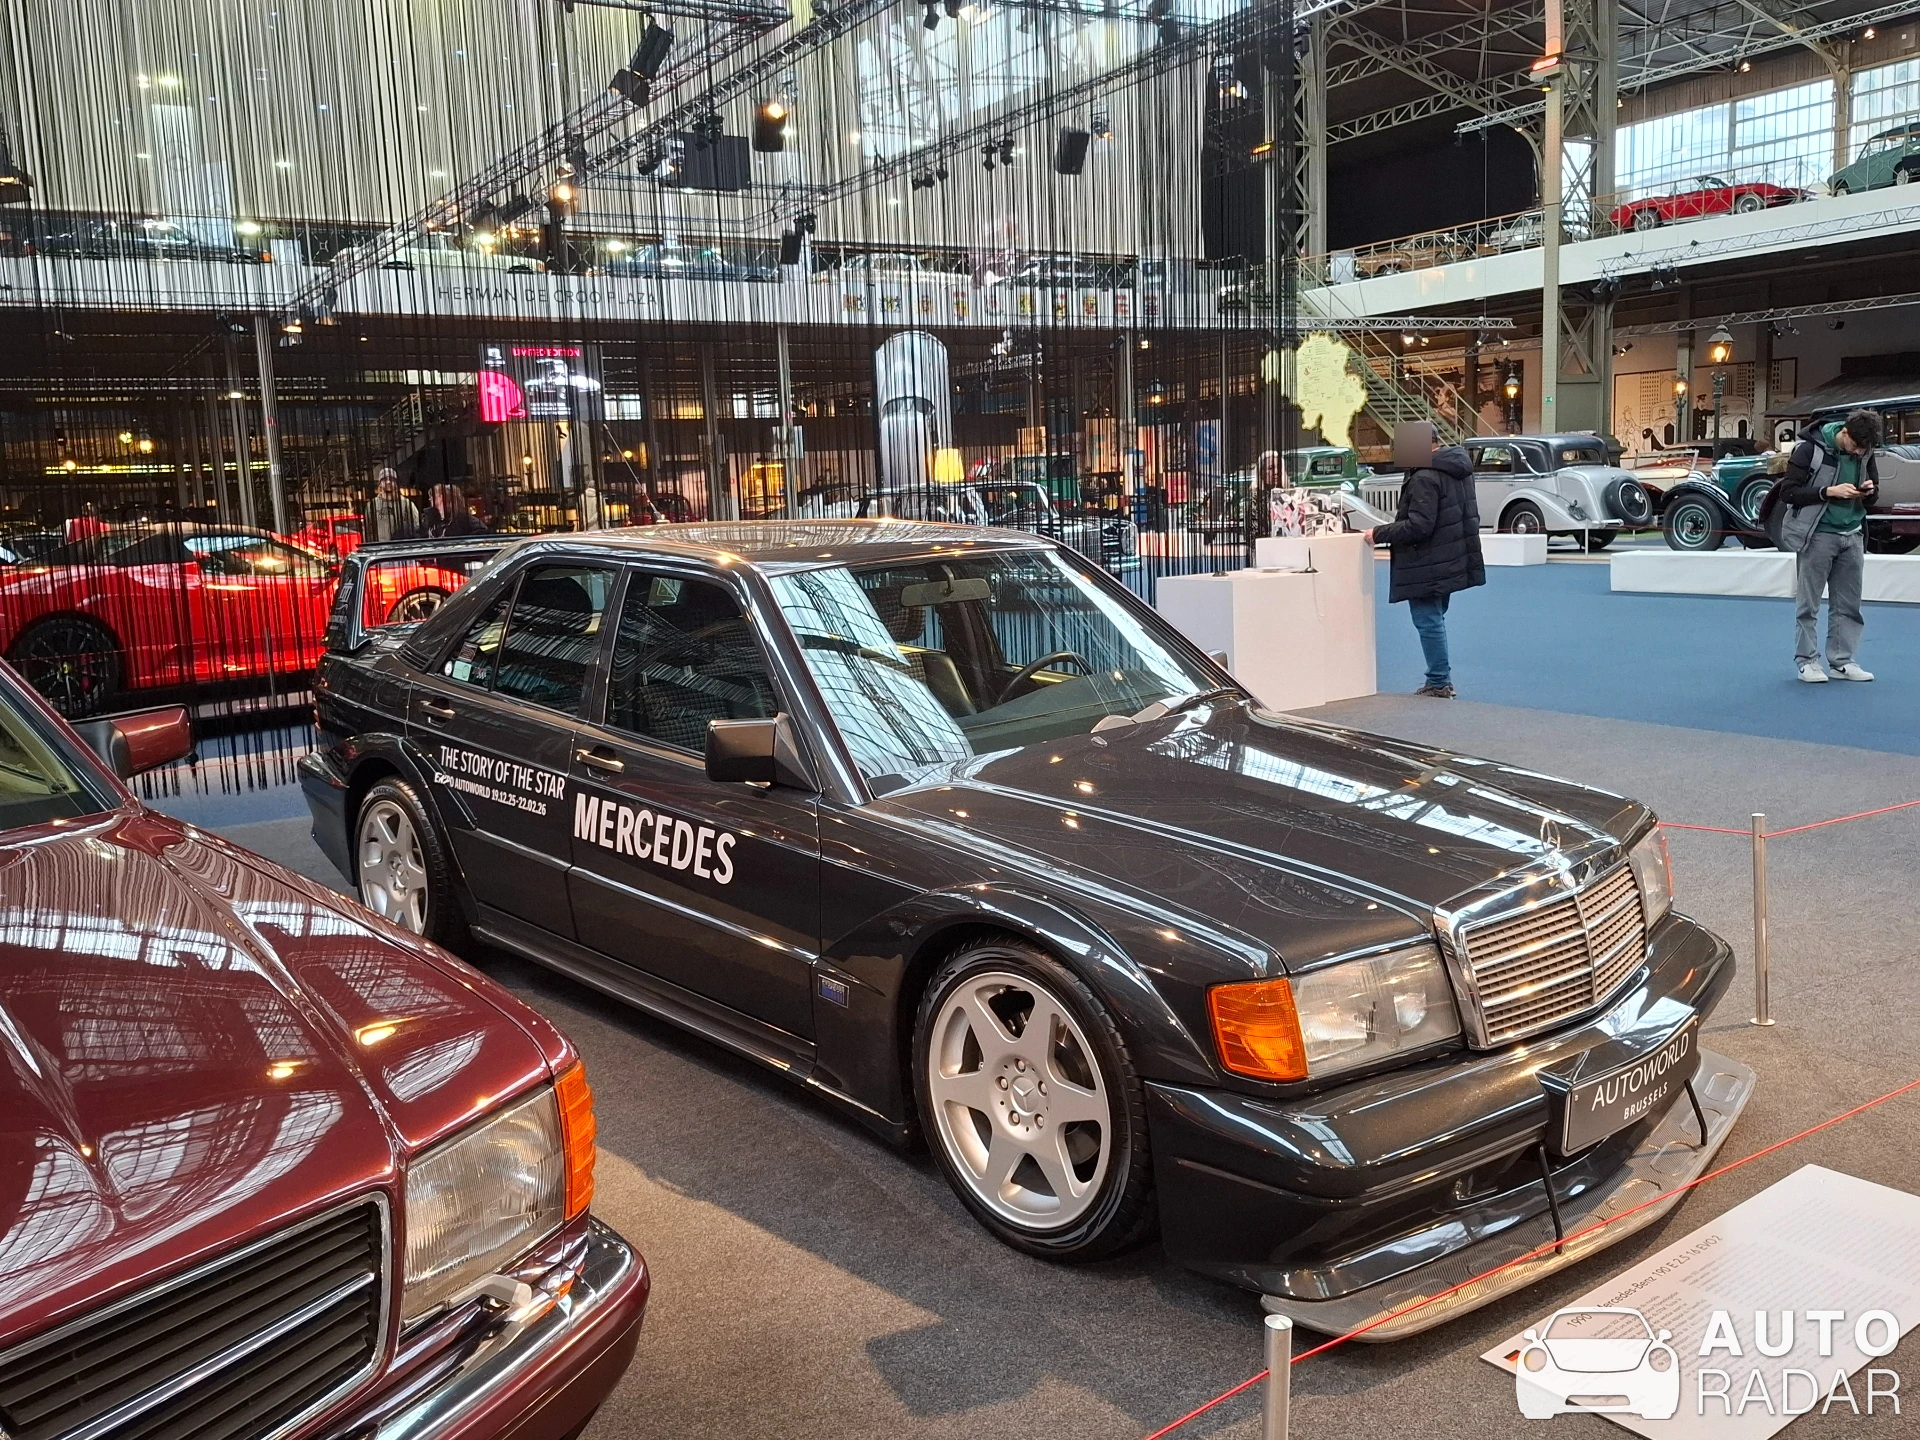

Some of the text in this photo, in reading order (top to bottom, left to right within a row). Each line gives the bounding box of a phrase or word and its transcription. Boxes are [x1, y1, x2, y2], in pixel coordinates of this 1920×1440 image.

[438, 286, 516, 301] HERMAN
[525, 289, 548, 302] DE
[607, 291, 657, 305] PLAZA
[440, 745, 566, 800] THE STORY OF THE STAR
[454, 777, 491, 799] AUTOWORLD
[573, 792, 737, 885] MERCEDES
[1591, 1032, 1689, 1112] AUTOWORLD
[1623, 1081, 1668, 1120] BRUSSELS
[1566, 1313, 1593, 1328] 1990
[1652, 1266, 1671, 1277] 190
